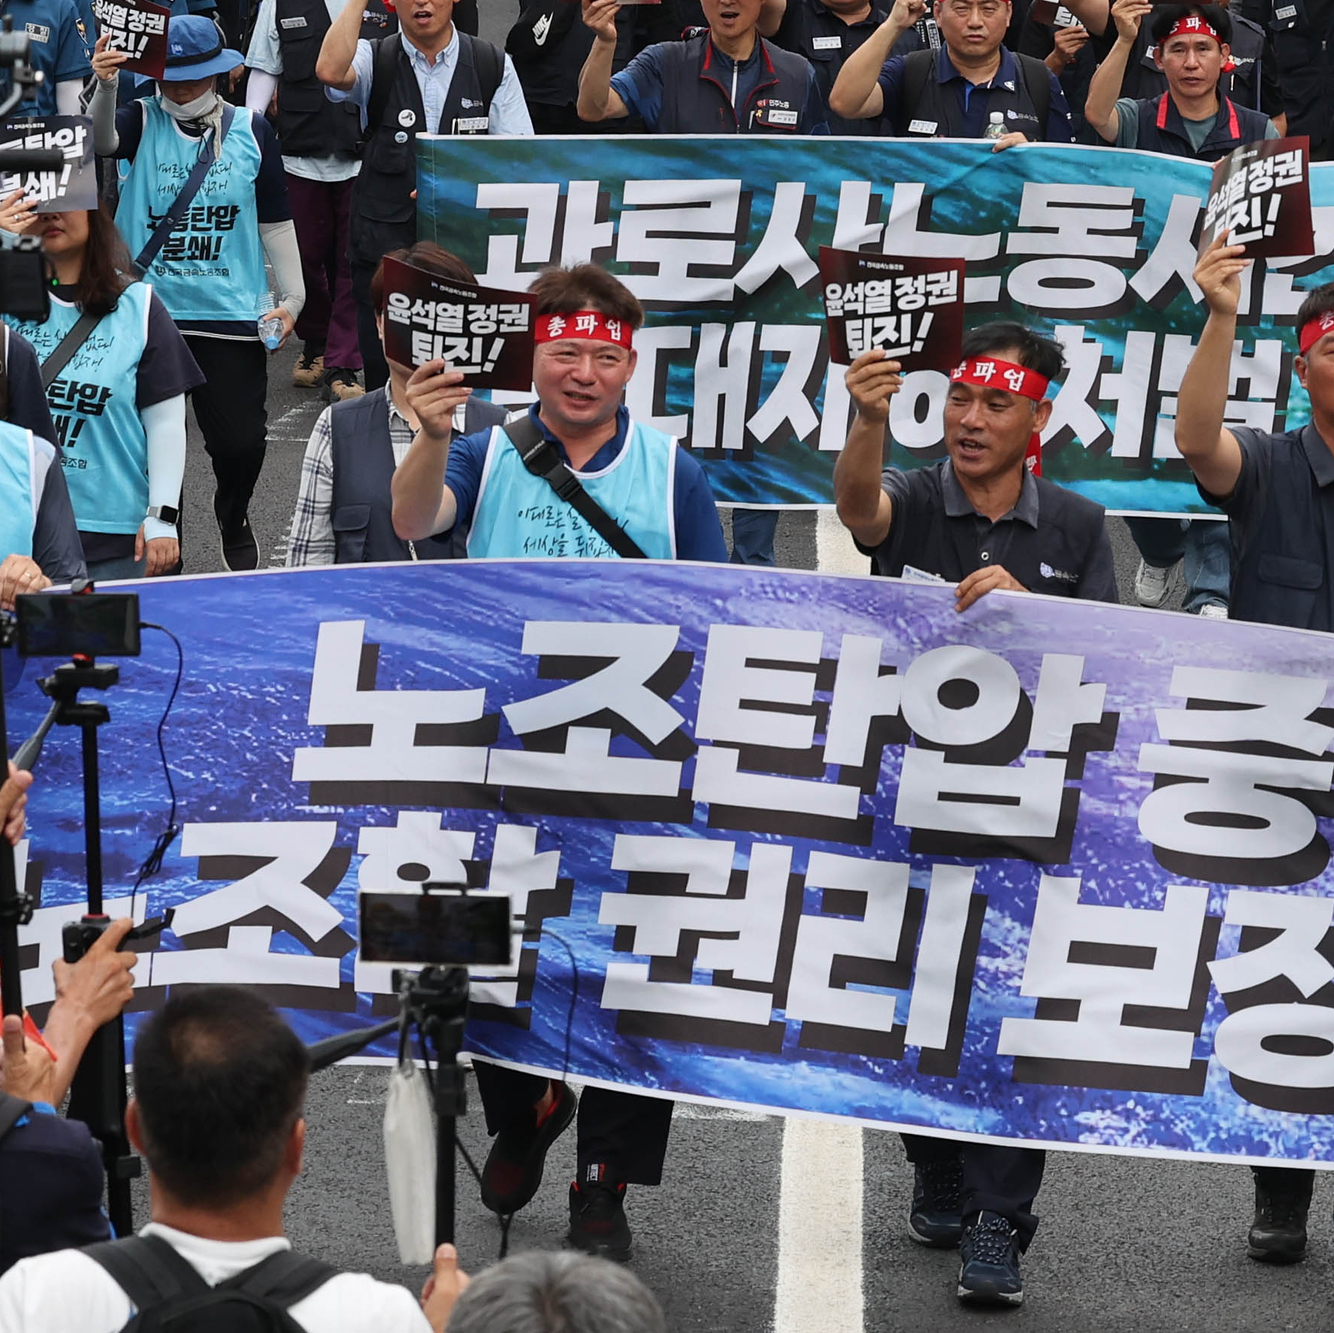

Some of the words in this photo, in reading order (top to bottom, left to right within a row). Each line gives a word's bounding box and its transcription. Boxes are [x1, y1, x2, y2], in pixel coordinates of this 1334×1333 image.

[532, 14, 551, 36] NIKE
[387, 292, 467, 333] 윤석열
[466, 303, 530, 334] 정권
[824, 278, 893, 317] 윤석열
[892, 270, 958, 310] 정권
[410, 329, 505, 374] 퇴진!
[844, 312, 932, 361] 퇴진!
[291, 618, 1107, 842] 노조탄압
[598, 832, 978, 1050] 권리
